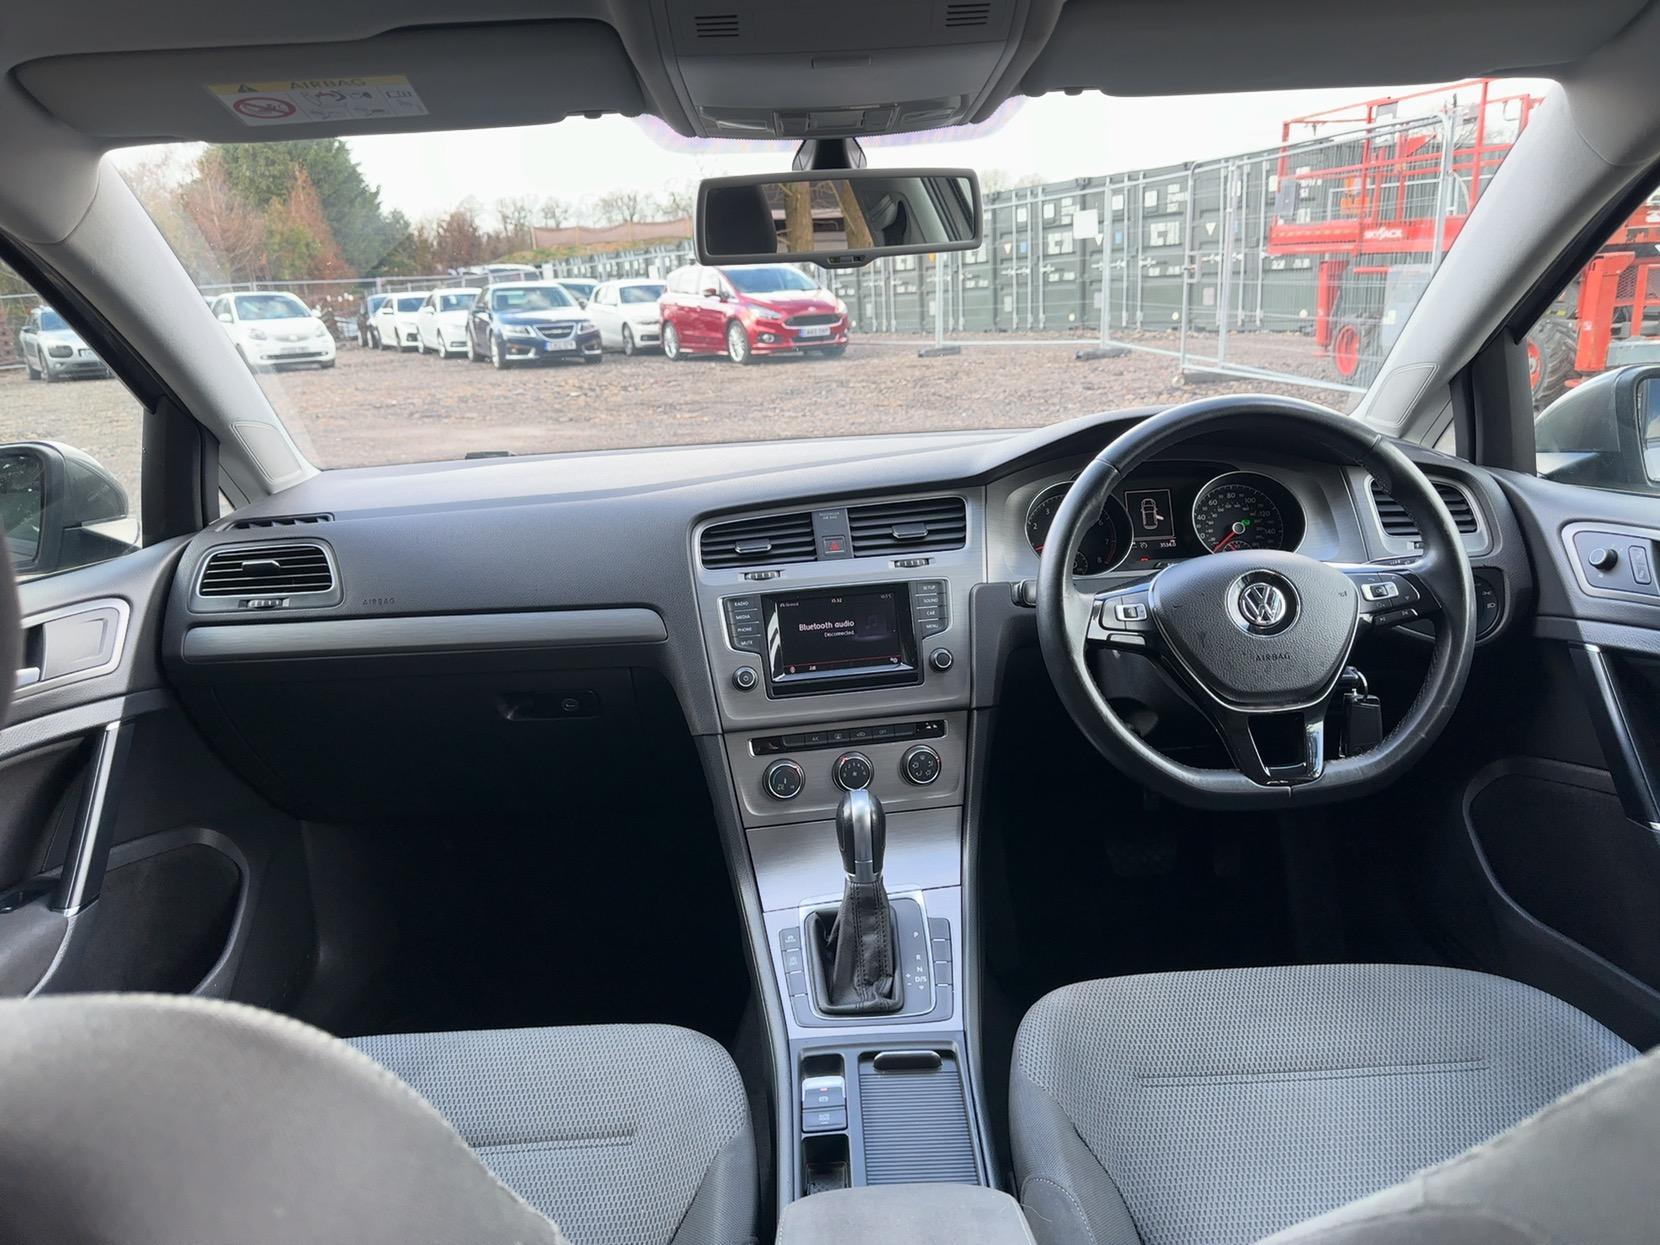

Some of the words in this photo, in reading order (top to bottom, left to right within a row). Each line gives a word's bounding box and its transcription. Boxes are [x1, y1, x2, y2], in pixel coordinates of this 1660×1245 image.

[290, 78, 366, 90] AIRBAG
[362, 597, 395, 606] AIRBAG
[798, 621, 833, 631] Bluetooth
[834, 620, 855, 628] audio
[1255, 653, 1291, 662] AIRBAG
